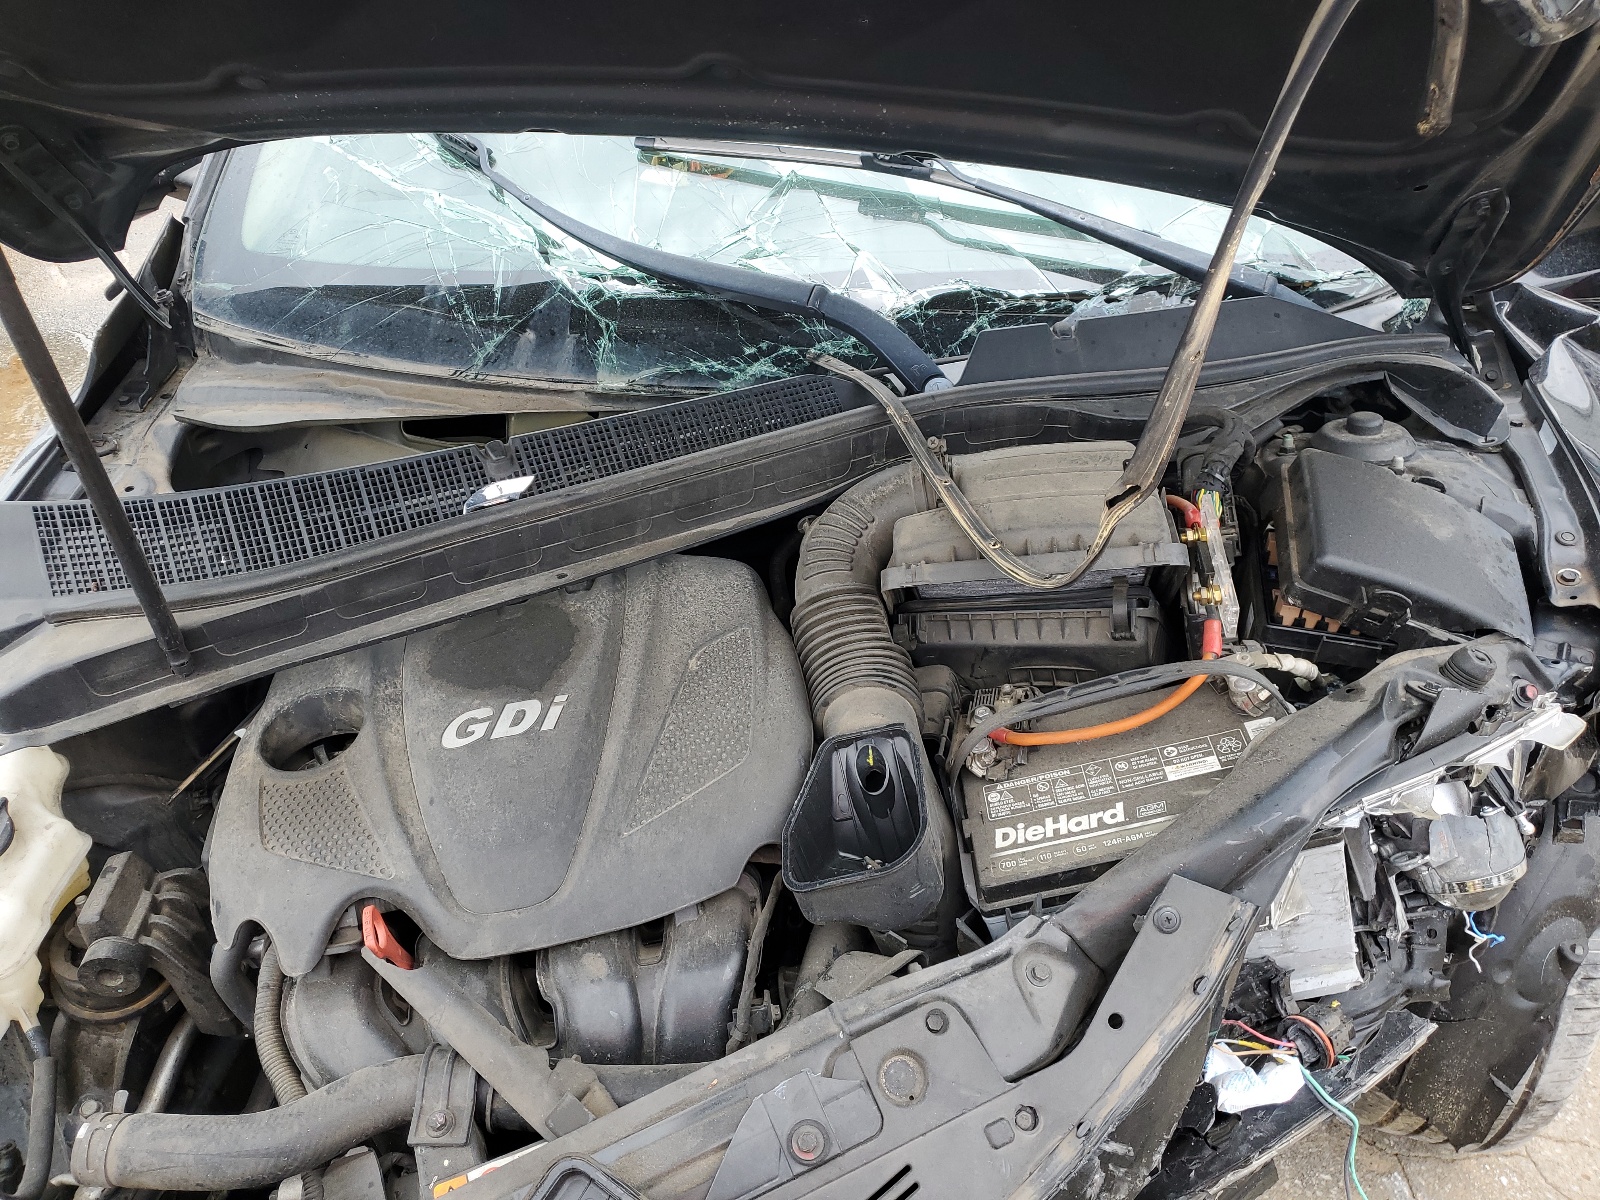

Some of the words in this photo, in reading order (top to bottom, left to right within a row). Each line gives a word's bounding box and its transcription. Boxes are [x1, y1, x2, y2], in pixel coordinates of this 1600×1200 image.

[441, 694, 569, 749] GDi
[1003, 769, 1071, 788] DANGER/POISON
[995, 801, 1125, 849] DieHard
[1103, 832, 1144, 847] 124R-AGM
[1039, 852, 1052, 861] 110
[1075, 845, 1087, 853] 60
[1000, 860, 1017, 869] 700
